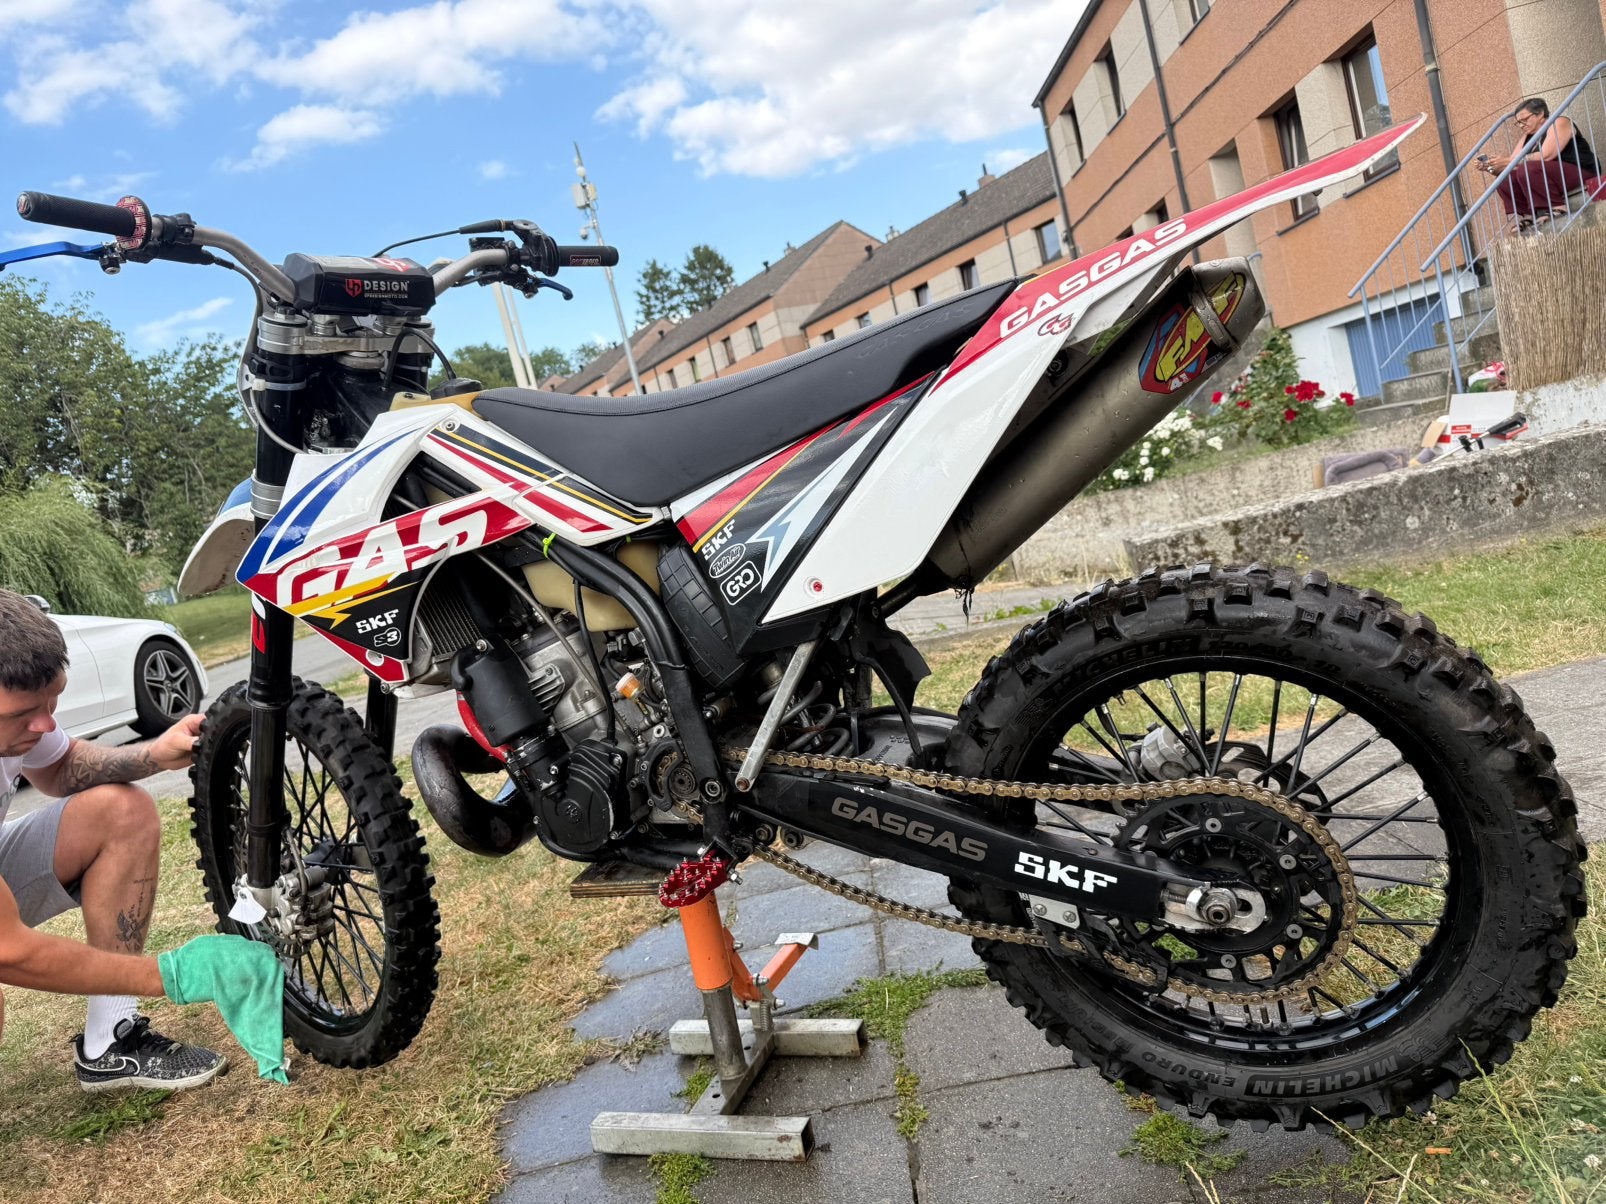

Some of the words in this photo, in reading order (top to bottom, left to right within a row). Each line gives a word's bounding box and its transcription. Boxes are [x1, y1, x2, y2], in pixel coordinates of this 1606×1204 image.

[364, 281, 408, 291] DESIGN
[1000, 218, 1187, 339] GASGAS
[276, 497, 488, 607] GAS
[701, 519, 735, 560] SKF
[726, 568, 754, 597] GRO
[355, 609, 399, 634] SKF
[831, 797, 988, 862] GASGAS
[1014, 851, 1118, 893] SKF
[1140, 1049, 1237, 1089] ENDURO
[1252, 1055, 1399, 1095] MICHELIN
